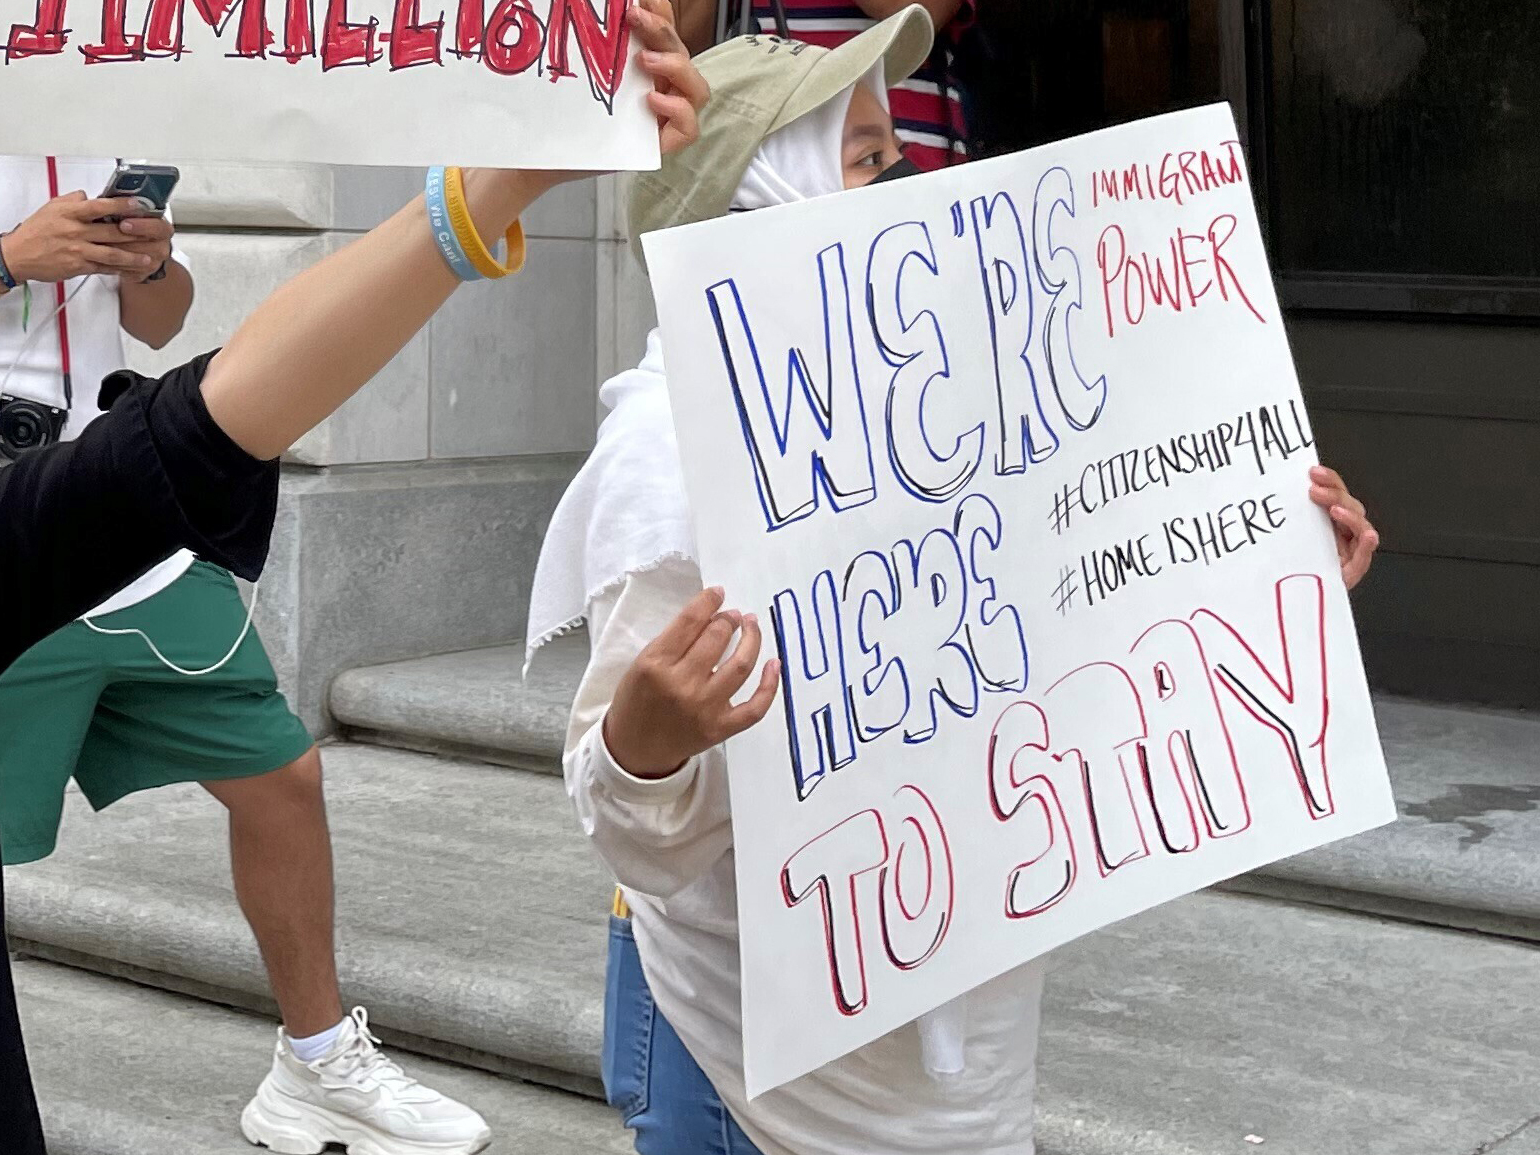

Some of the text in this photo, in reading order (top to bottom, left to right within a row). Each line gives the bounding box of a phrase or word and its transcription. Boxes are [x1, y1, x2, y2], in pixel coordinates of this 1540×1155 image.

[1091, 139, 1243, 208] IMMIGRANT
[1096, 213, 1267, 339] POWER
[706, 165, 1108, 534] WE'RE
[1047, 399, 1315, 536] #CITIZENSHIP4ALL
[769, 493, 1030, 803] HERE
[780, 573, 1335, 1017] TO STAY
